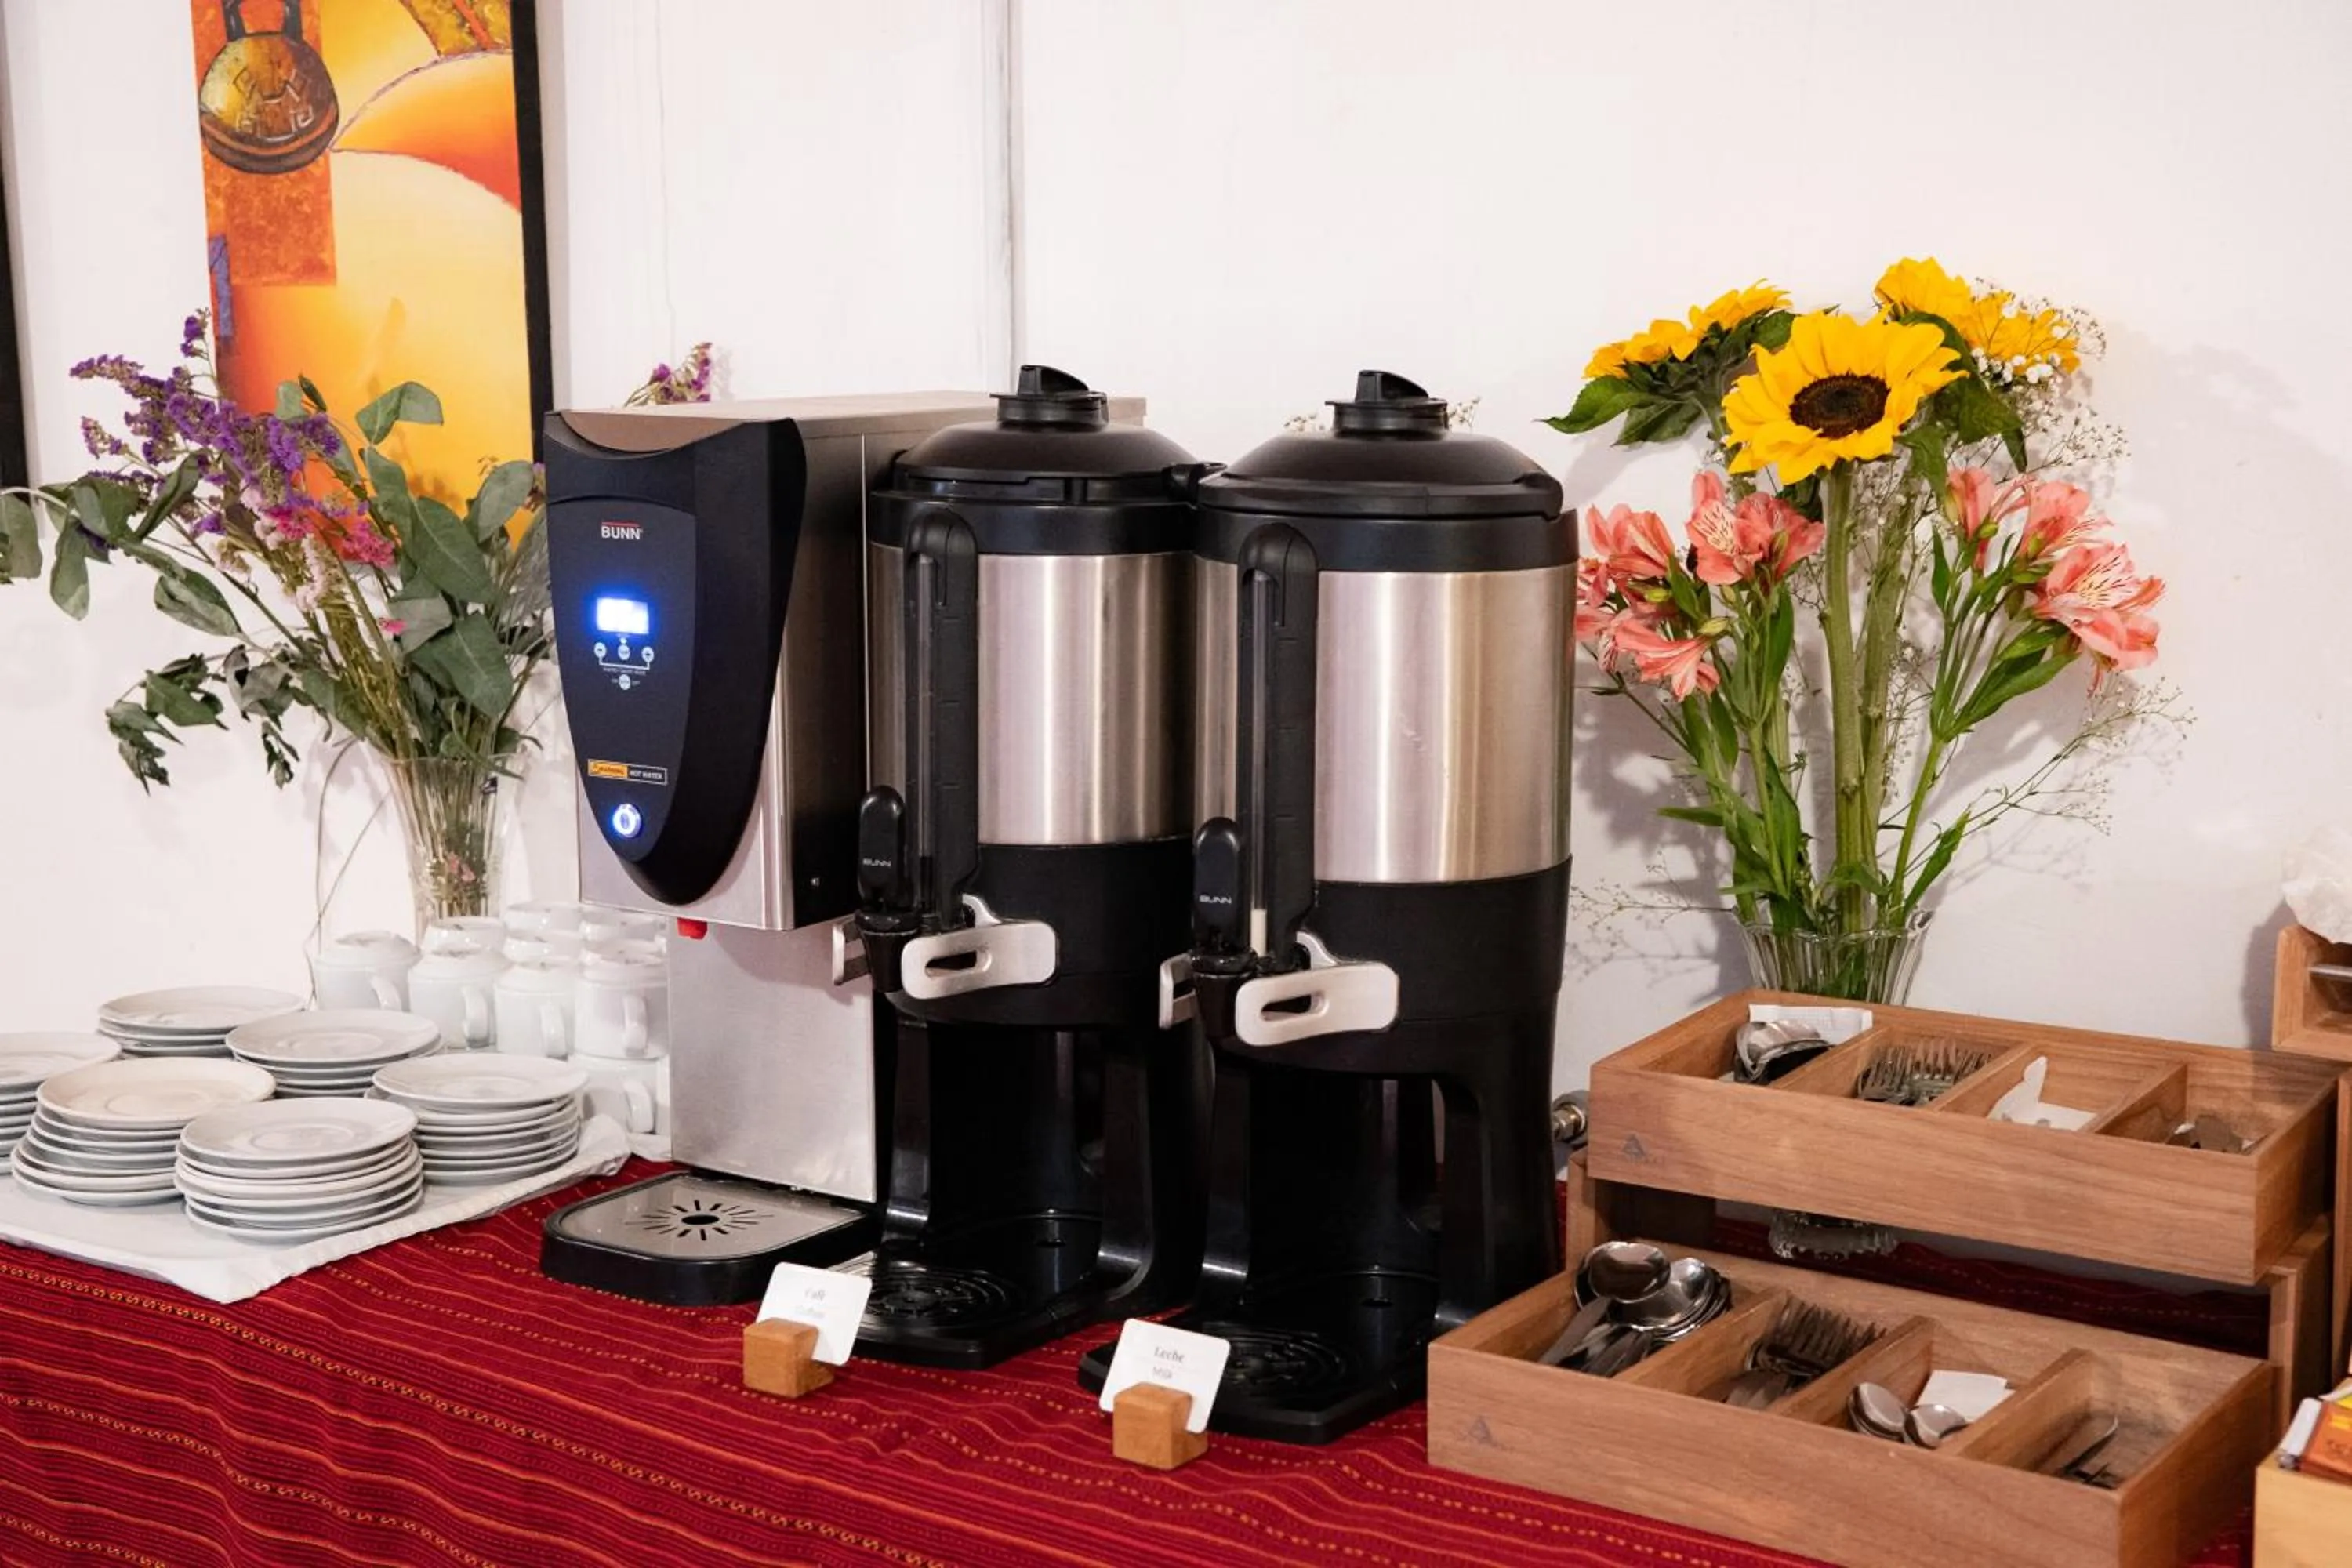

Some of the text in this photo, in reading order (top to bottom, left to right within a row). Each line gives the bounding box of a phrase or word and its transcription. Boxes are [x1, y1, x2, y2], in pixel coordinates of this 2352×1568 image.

[601, 525, 641, 540] BUNN
[862, 858, 891, 867] BUNN
[1199, 895, 1232, 904] BUNN
[1153, 1346, 1185, 1363] Leche
